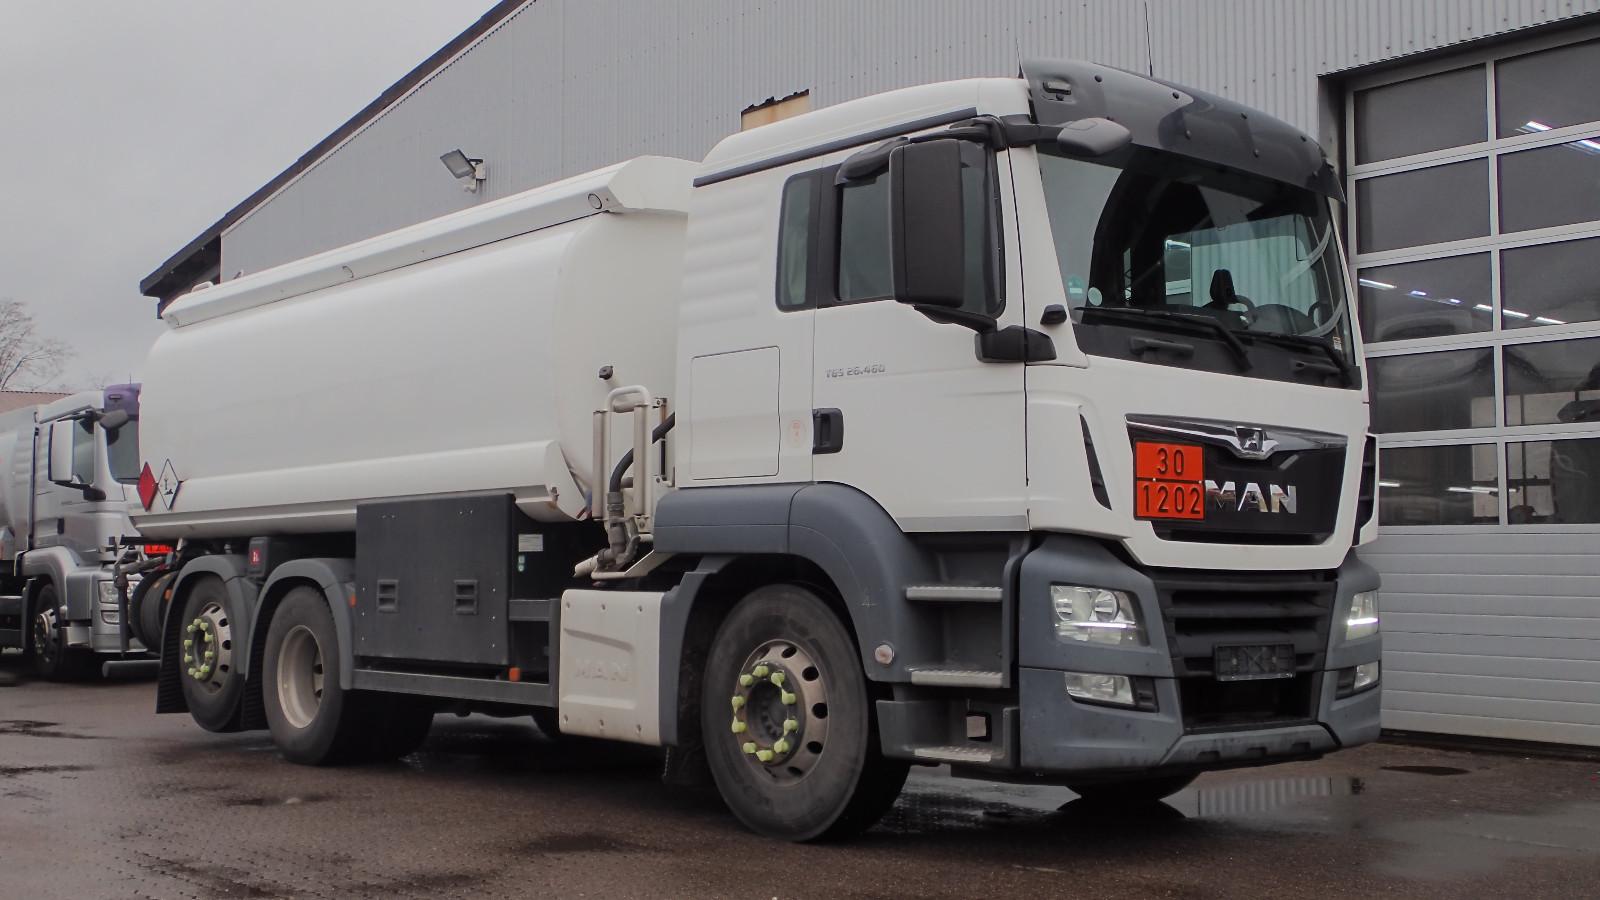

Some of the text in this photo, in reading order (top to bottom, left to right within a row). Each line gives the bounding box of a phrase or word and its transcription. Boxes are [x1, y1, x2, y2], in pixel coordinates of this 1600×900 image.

[1157, 448, 1185, 476] 30
[1142, 484, 1202, 515] 1202
[1205, 479, 1297, 514] MAN
